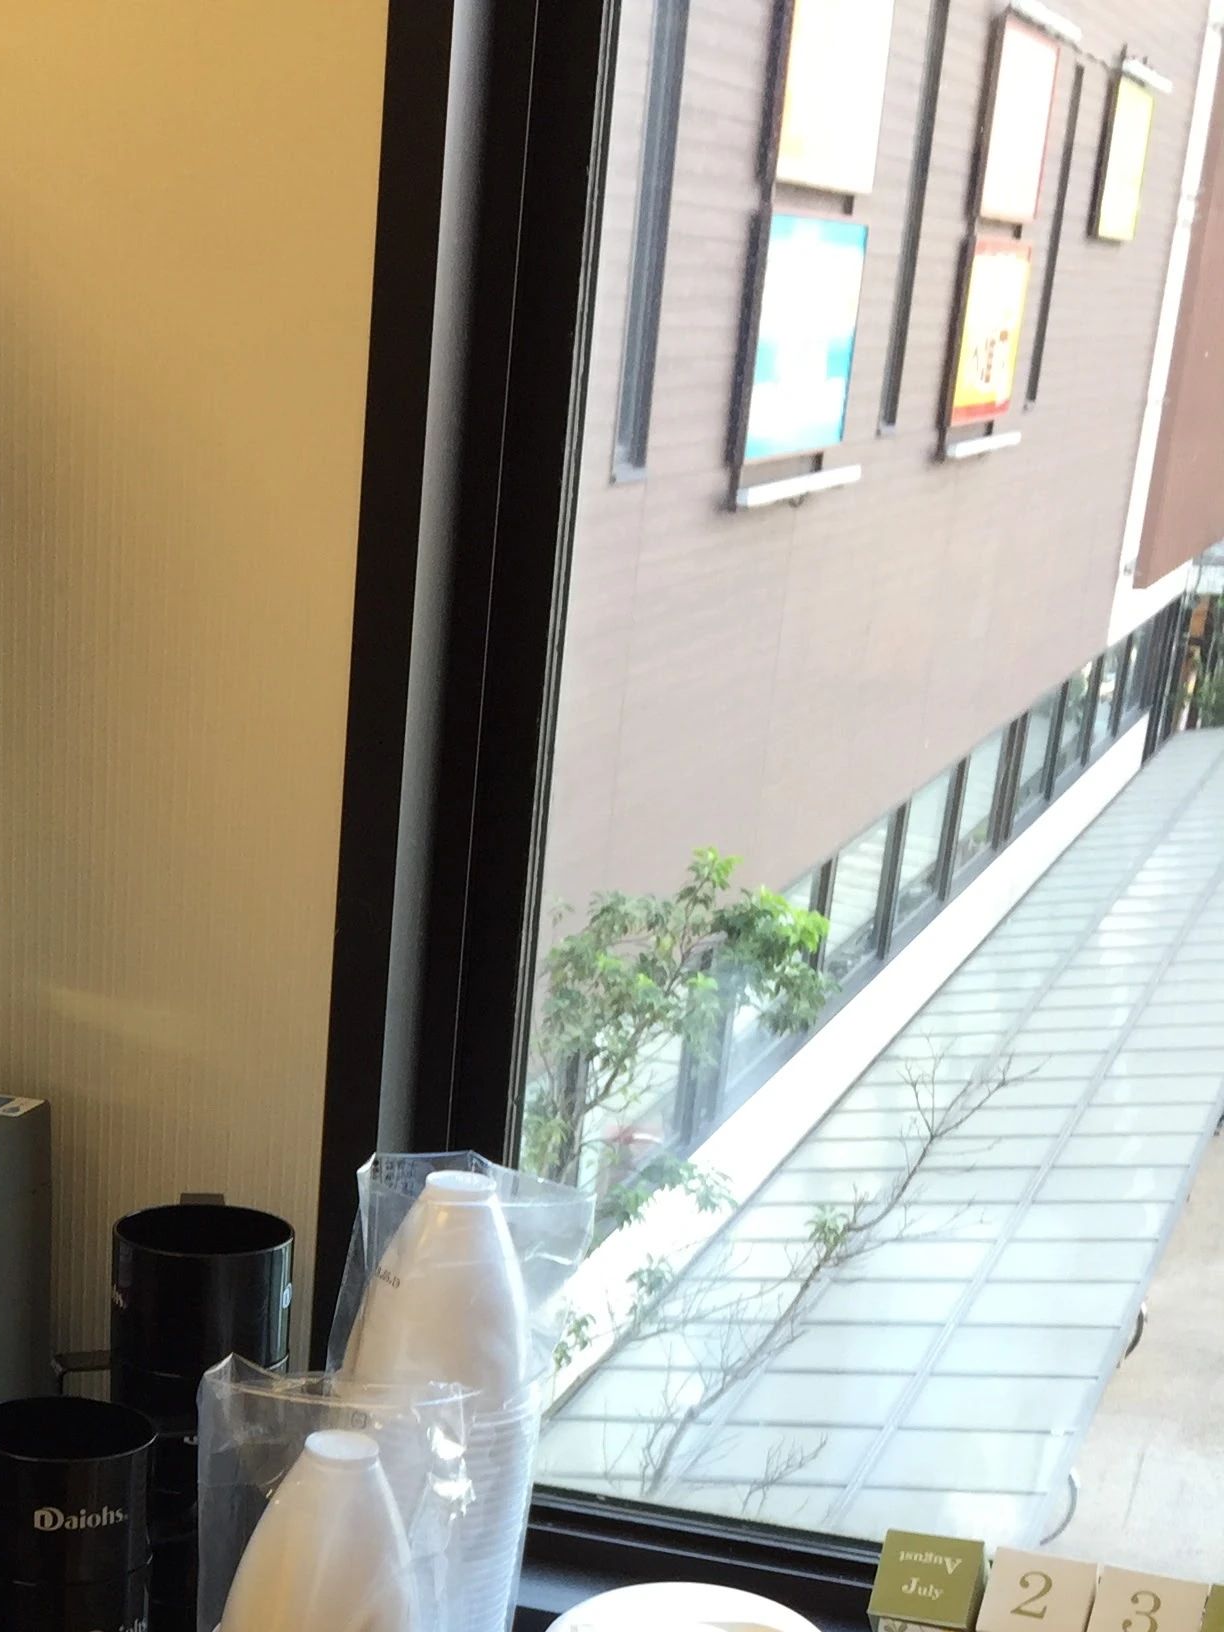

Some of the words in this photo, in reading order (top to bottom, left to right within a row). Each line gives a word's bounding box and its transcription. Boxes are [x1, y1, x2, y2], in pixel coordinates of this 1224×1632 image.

[33, 1505, 124, 1531] Daiohs
[901, 1576, 944, 1600] July
[1010, 1571, 1054, 1619] 2
